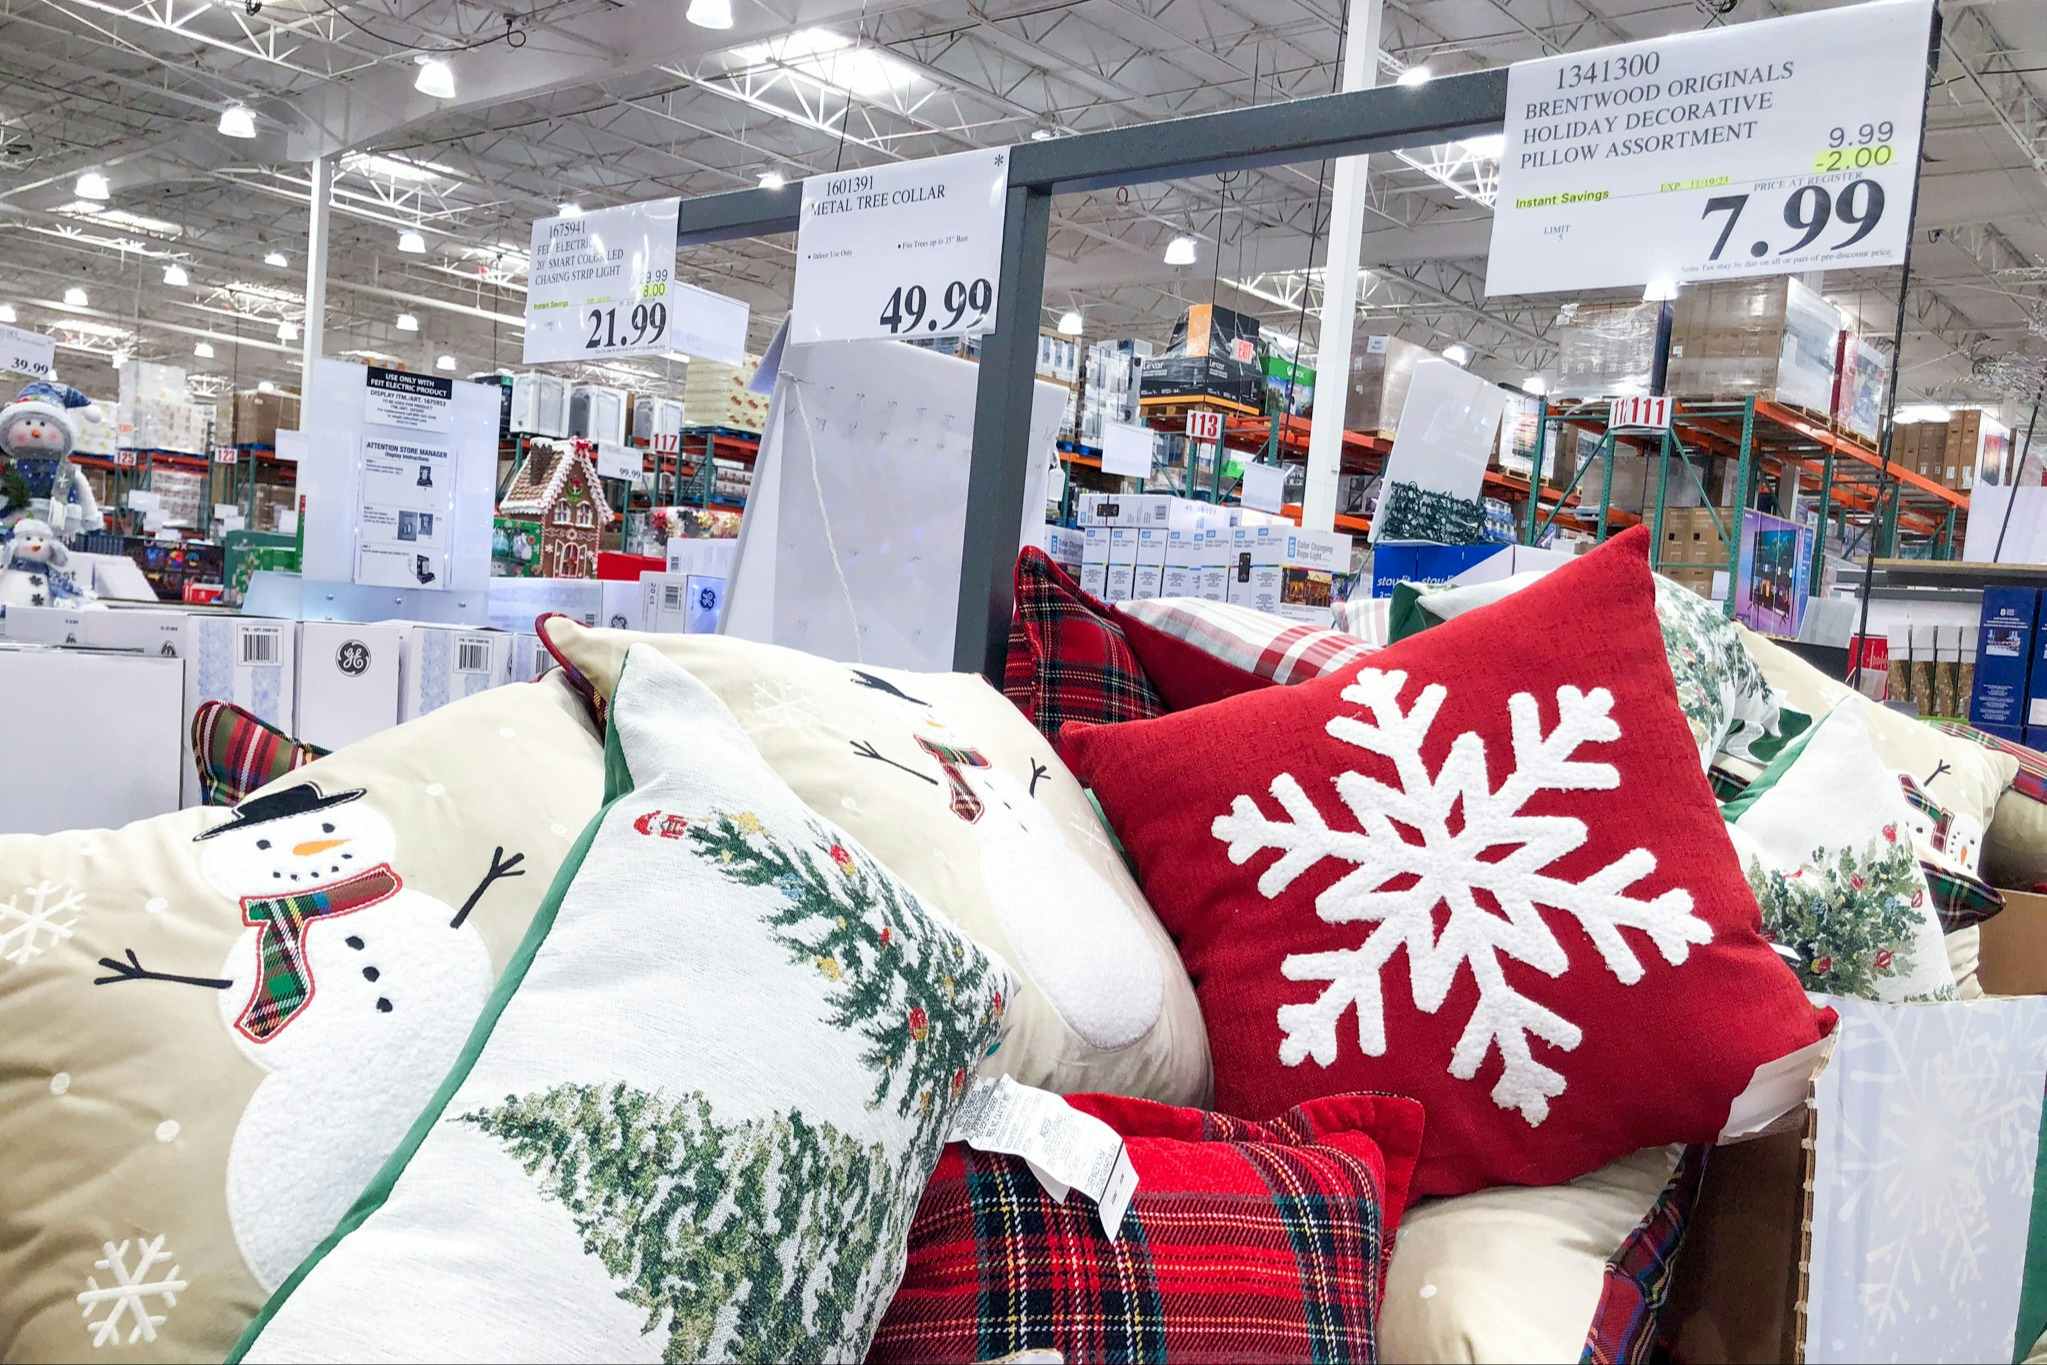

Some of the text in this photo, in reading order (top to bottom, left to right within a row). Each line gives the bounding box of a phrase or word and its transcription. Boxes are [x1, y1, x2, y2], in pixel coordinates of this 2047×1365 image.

[1556, 51, 1661, 91] 1341300
[1525, 61, 1795, 120] BRENTWOOD ORIGINALS
[1522, 91, 1775, 145] HOLIDAY DECORATIVE
[1520, 120, 1759, 169] PILLOW ASSORTMENT
[1828, 120, 1895, 149] 9.99
[1815, 144, 1893, 172] -2.00
[826, 175, 874, 197] 1601391
[1753, 179, 1785, 192] PRICE
[1807, 171, 1864, 187] REGISTER
[811, 184, 946, 217] METAL TREE COLLAR
[1515, 189, 1610, 209] Instant Savings
[549, 220, 586, 238] 1675941
[1544, 223, 1571, 235] LIMIT
[1701, 178, 1886, 261] 7.99
[548, 254, 575, 269] SMART
[606, 248, 624, 261] LED
[535, 264, 621, 286] CHASING STRIP LIGHT
[879, 278, 993, 334] 49.99
[585, 302, 667, 349] 21.99
[10, 357, 49, 375] 39.99
[370, 378, 448, 397] FEIT ELECTRIC PRODUCT
[385, 373, 435, 387] USE ONLY WITH
[370, 389, 395, 398] DISPLAY
[1631, 396, 1665, 425] 111
[1190, 412, 1218, 438] 113
[366, 442, 448, 459] ATTENTION STORE MANAGER
[653, 433, 678, 451] 117
[217, 449, 236, 463] 123
